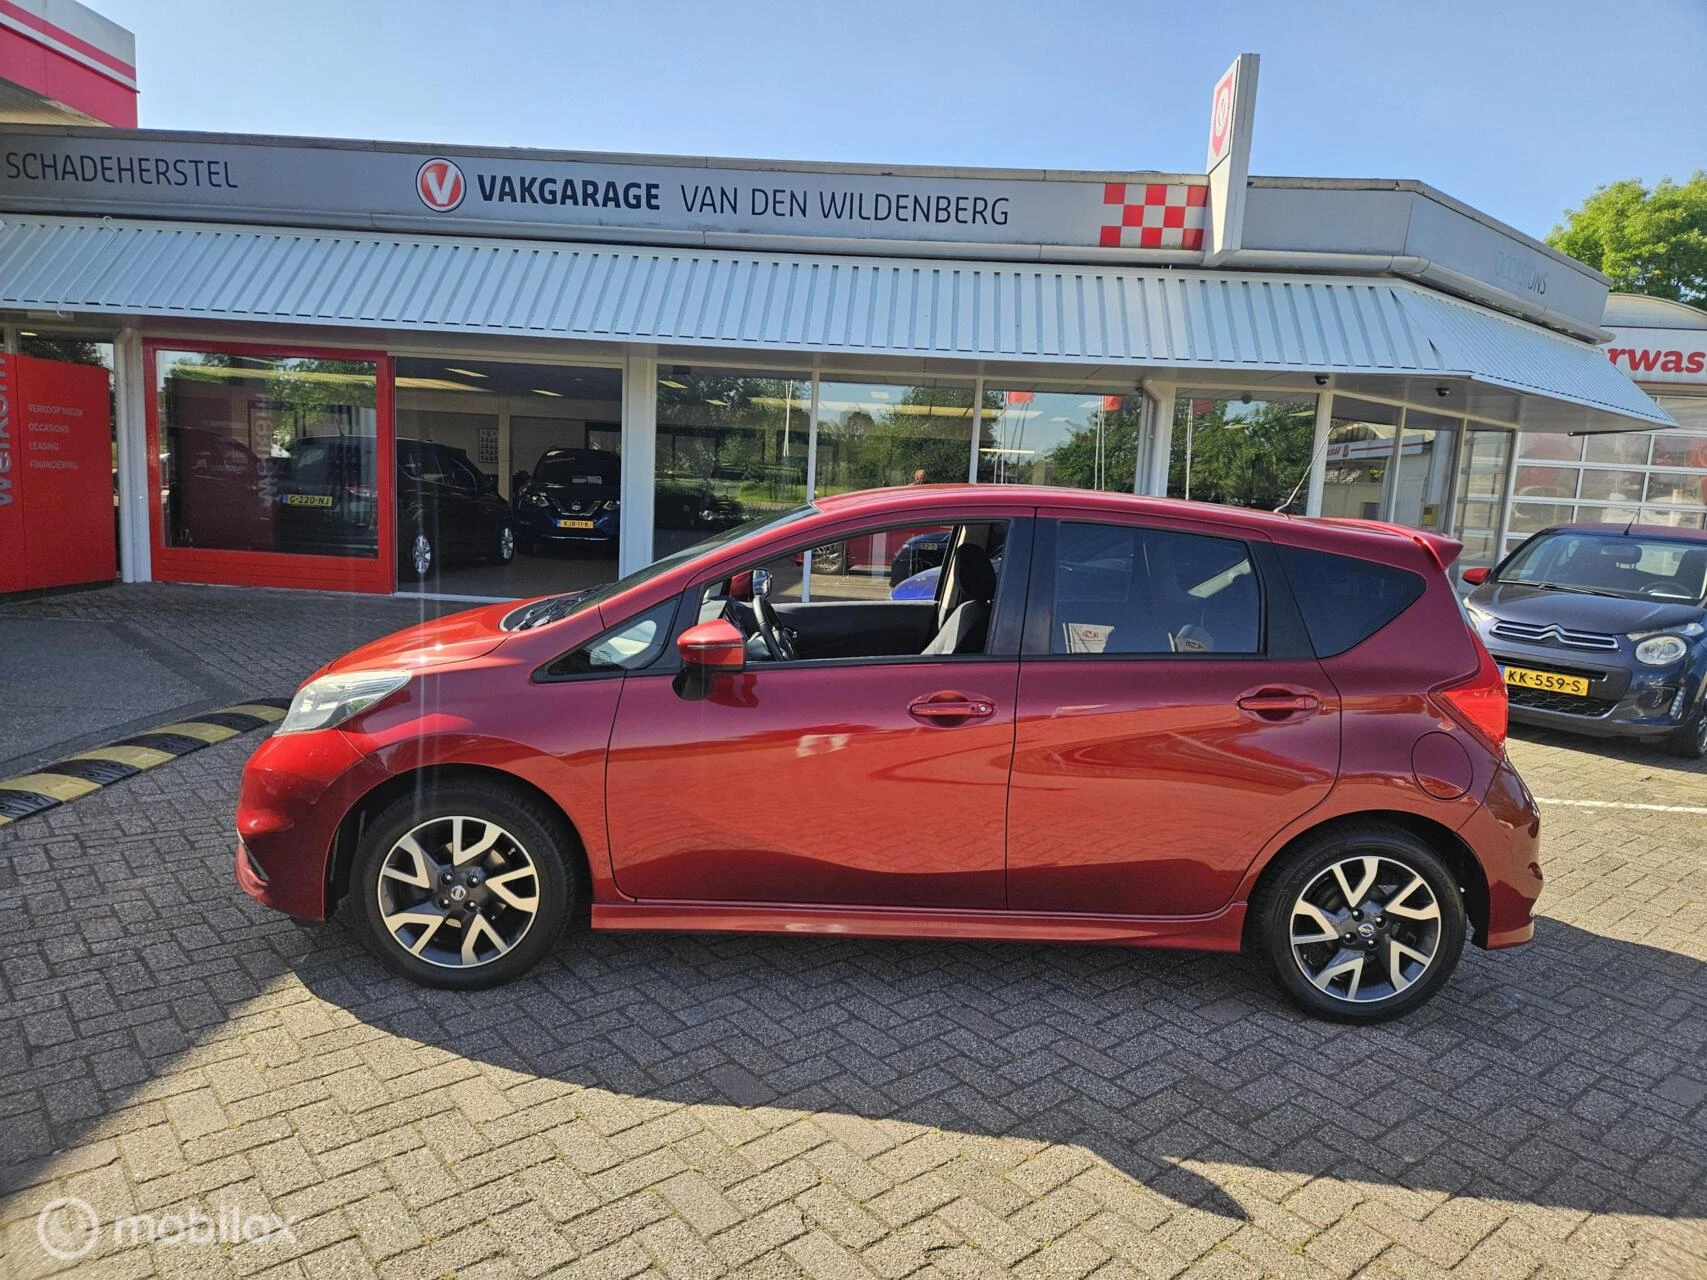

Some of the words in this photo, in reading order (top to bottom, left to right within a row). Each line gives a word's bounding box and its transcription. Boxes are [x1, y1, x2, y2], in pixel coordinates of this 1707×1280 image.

[5, 151, 239, 189] SCHADEHERSTEL
[478, 174, 661, 209] VAKGARAGE
[681, 183, 738, 215] VAN
[751, 188, 807, 218] DEN
[819, 191, 1010, 226] WILDENBERG
[1508, 669, 1581, 692] KK-559-S
